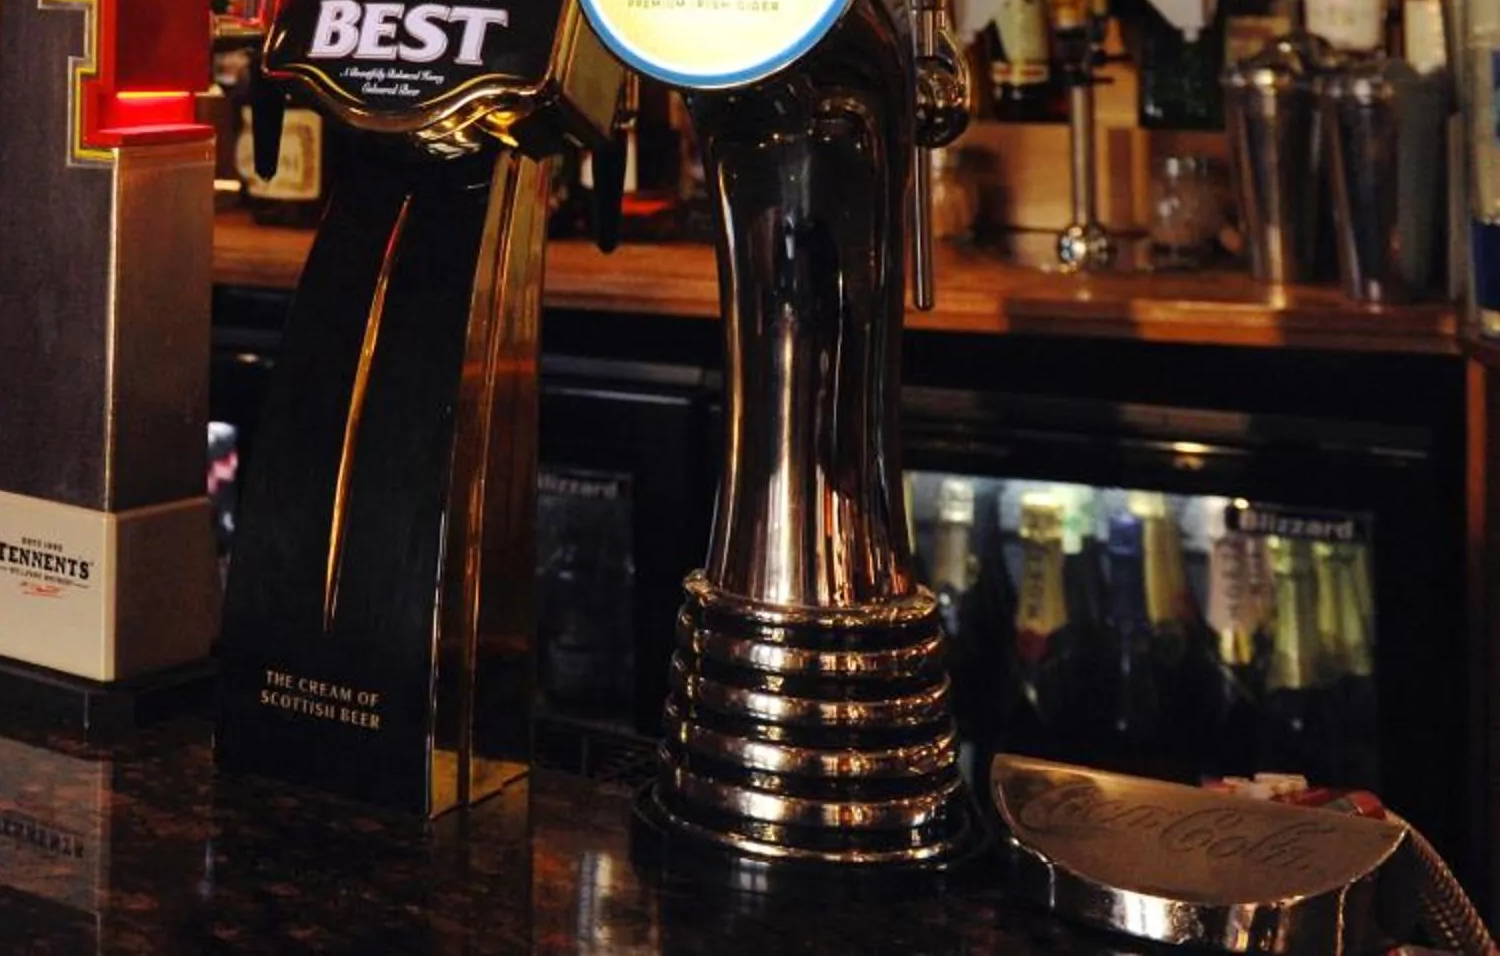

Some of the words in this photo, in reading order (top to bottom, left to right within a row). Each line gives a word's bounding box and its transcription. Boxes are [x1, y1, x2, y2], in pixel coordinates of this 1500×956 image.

[537, 473, 617, 500] lizzard
[266, 670, 293, 689] THE
[298, 678, 352, 703] CREAM
[357, 691, 380, 708] OF
[260, 689, 336, 719] SCOTTISH
[341, 707, 380, 730] BEER
